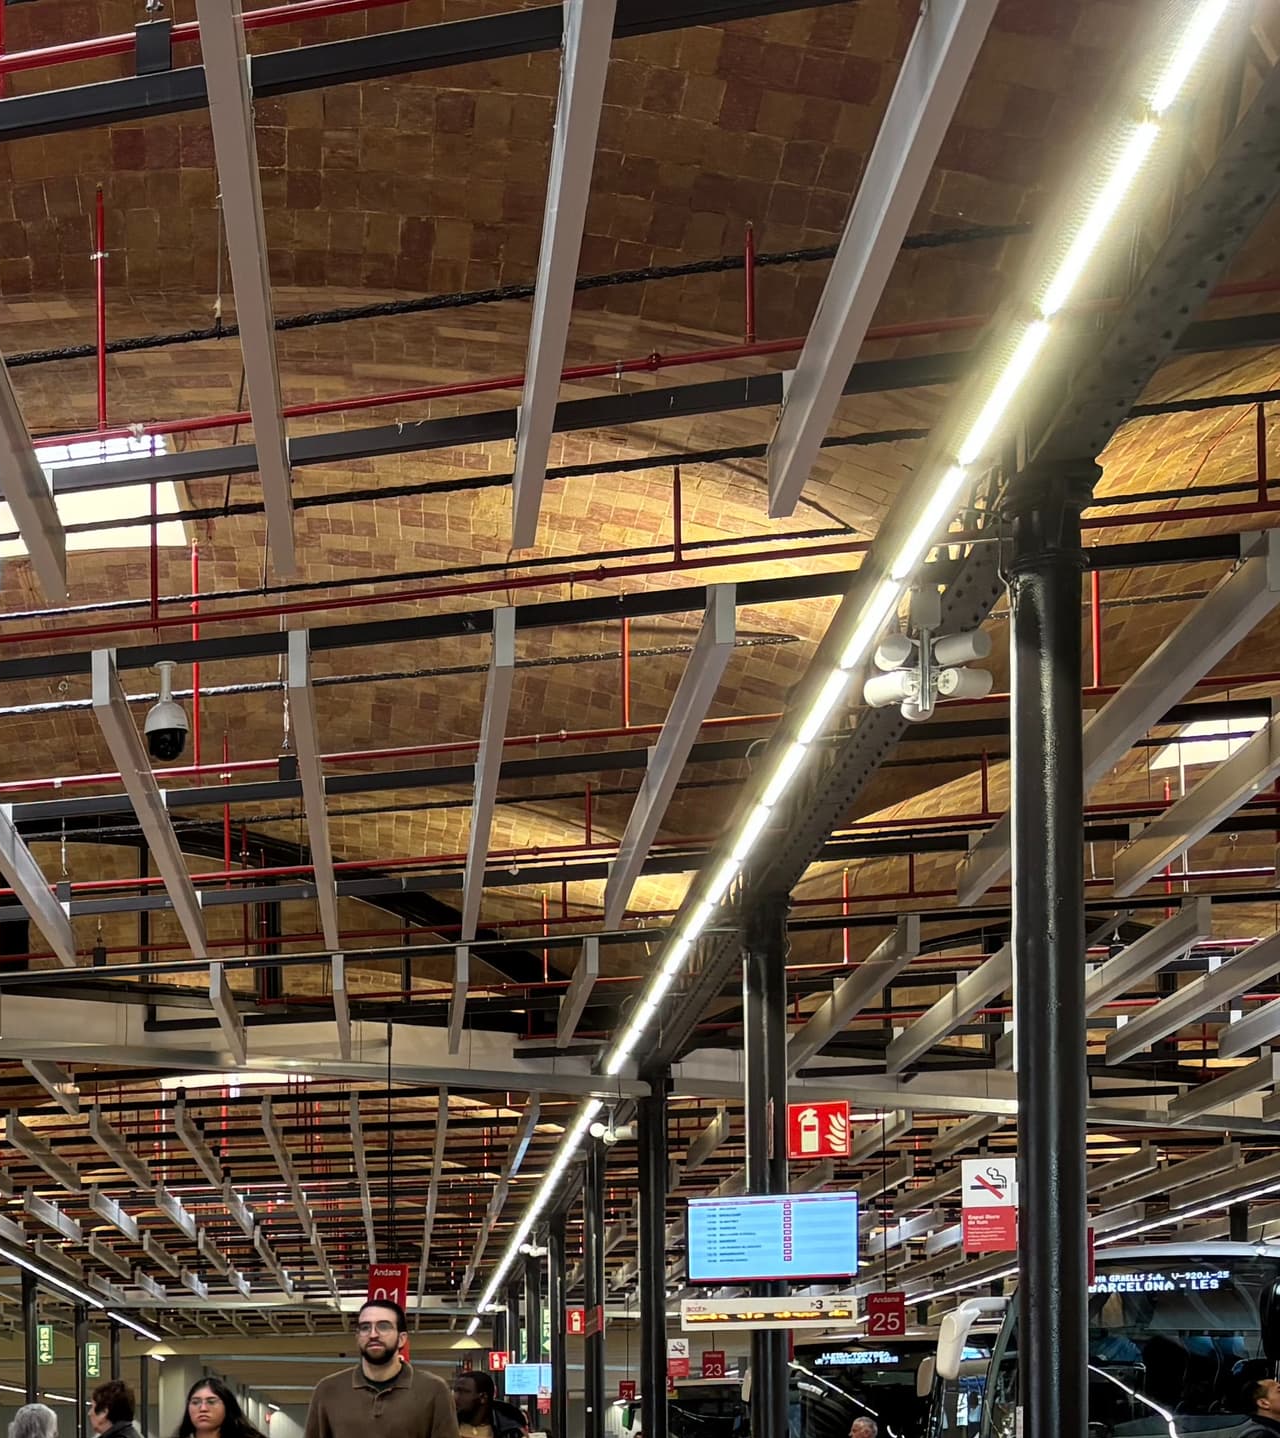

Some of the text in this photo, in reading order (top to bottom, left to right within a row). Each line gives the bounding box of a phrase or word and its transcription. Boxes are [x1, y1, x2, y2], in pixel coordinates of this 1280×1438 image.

[373, 1268, 401, 1276] Andana
[1088, 1281, 1175, 1293] BARCELONA
[1191, 1279, 1219, 1290] LES
[873, 1312, 900, 1331] 25
[705, 1363, 722, 1376] 23
[622, 1390, 634, 1400] 21
